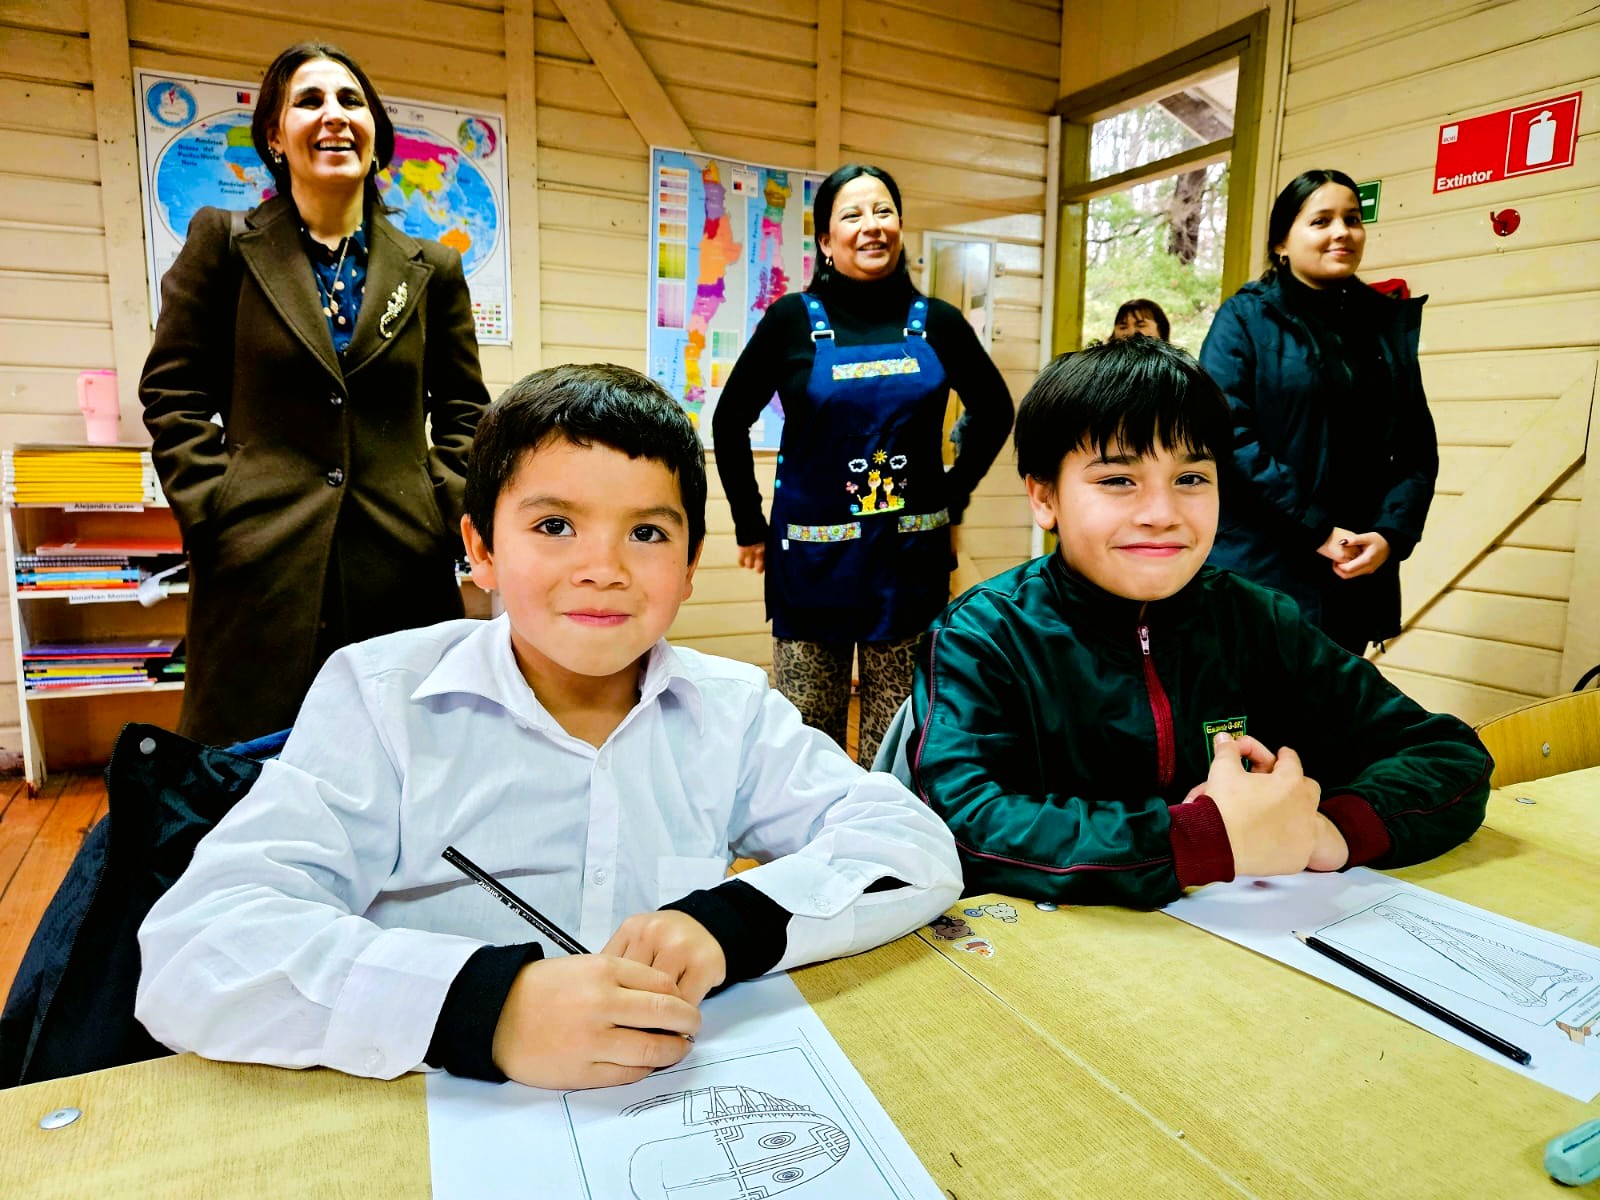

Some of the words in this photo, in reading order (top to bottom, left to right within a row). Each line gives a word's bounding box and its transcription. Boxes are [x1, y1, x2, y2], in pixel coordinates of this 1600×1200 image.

[1436, 169, 1493, 191] Extintor
[74, 502, 112, 511] Alejandro
[71, 593, 106, 601] Jonathan
